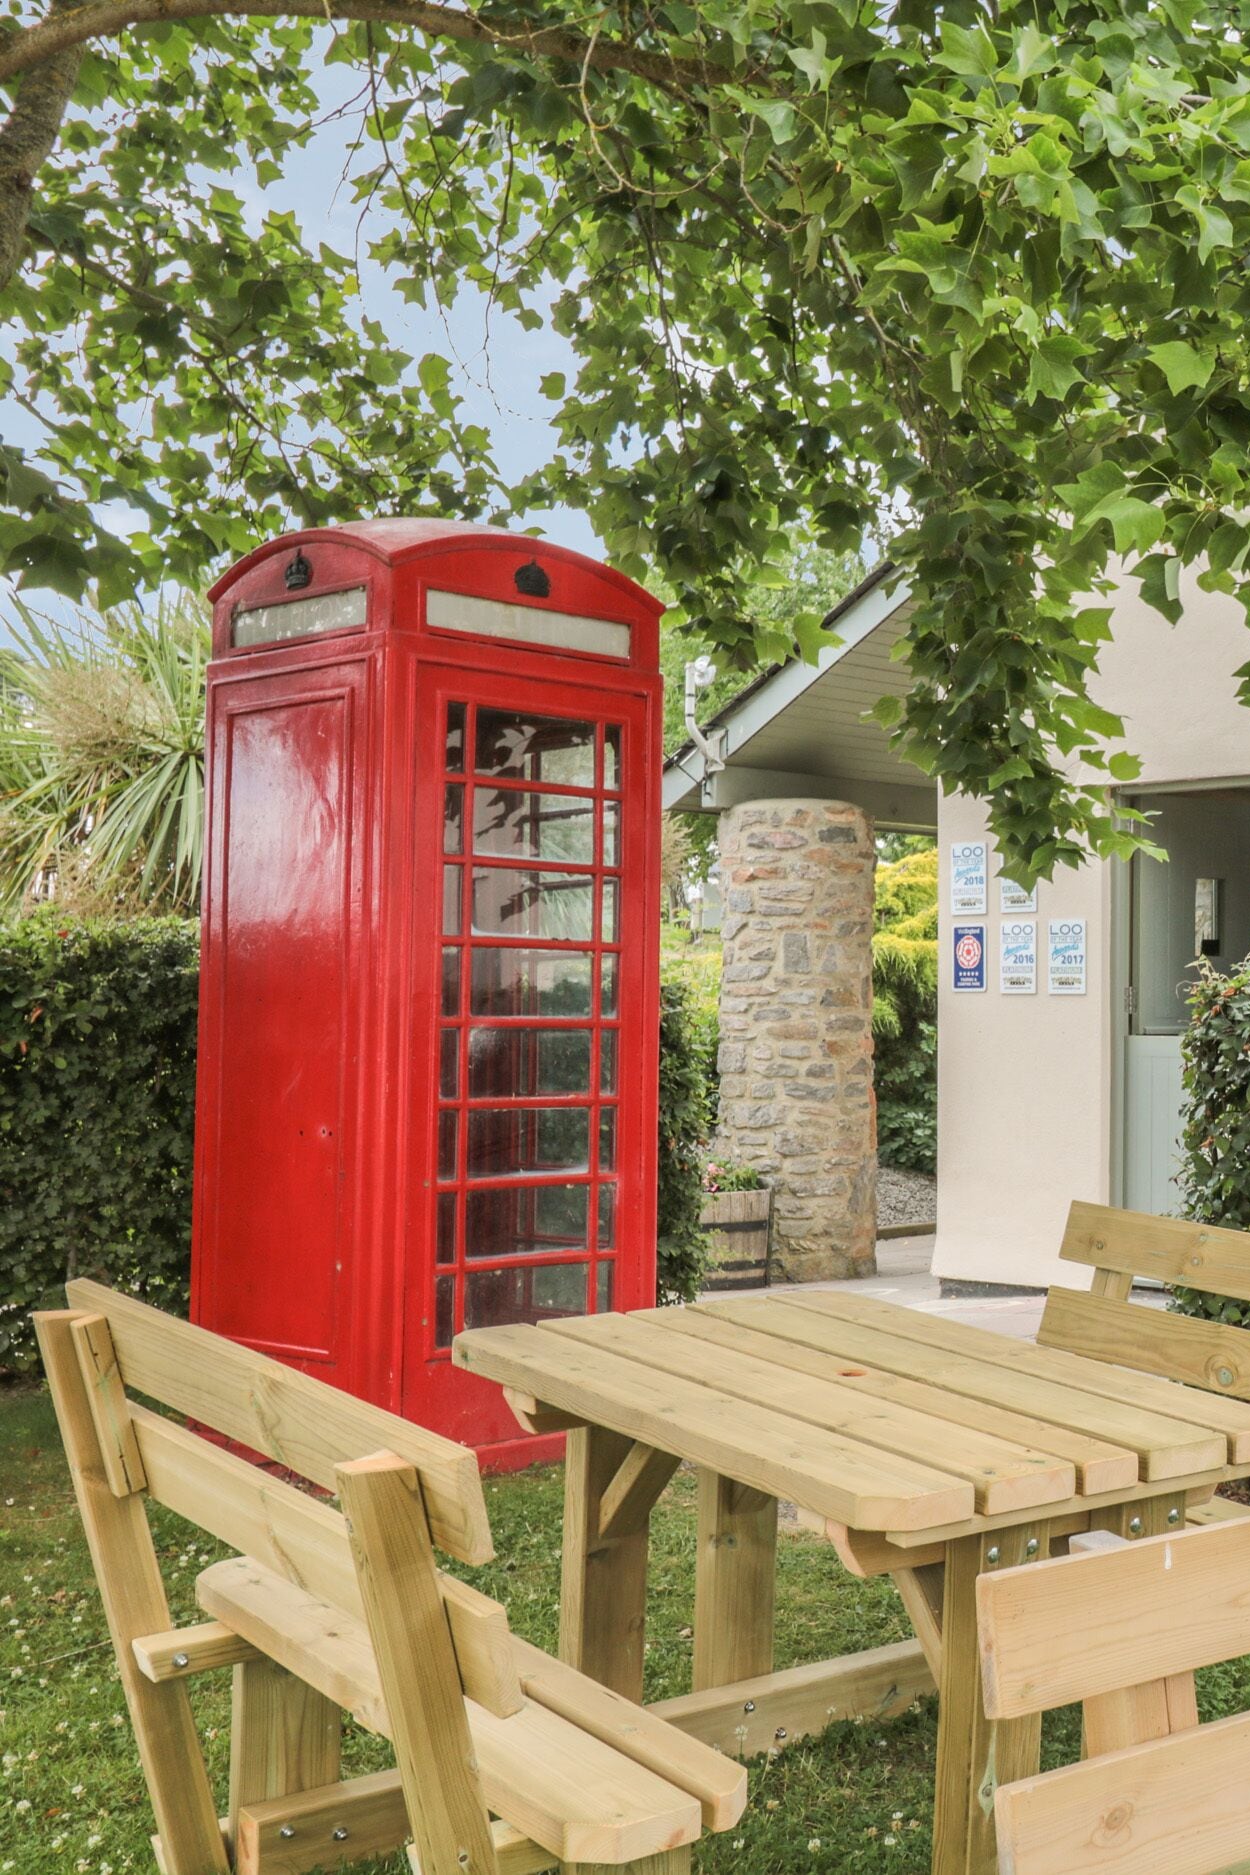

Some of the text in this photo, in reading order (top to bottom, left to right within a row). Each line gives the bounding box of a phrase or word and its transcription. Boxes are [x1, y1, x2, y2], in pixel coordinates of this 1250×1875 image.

[952, 846, 984, 857] LOO
[963, 876, 984, 886] 2018
[1002, 924, 1034, 936] LOO
[1050, 923, 1083, 936] LOO
[1013, 954, 1034, 964] 2016
[1061, 955, 1084, 965] 2017
